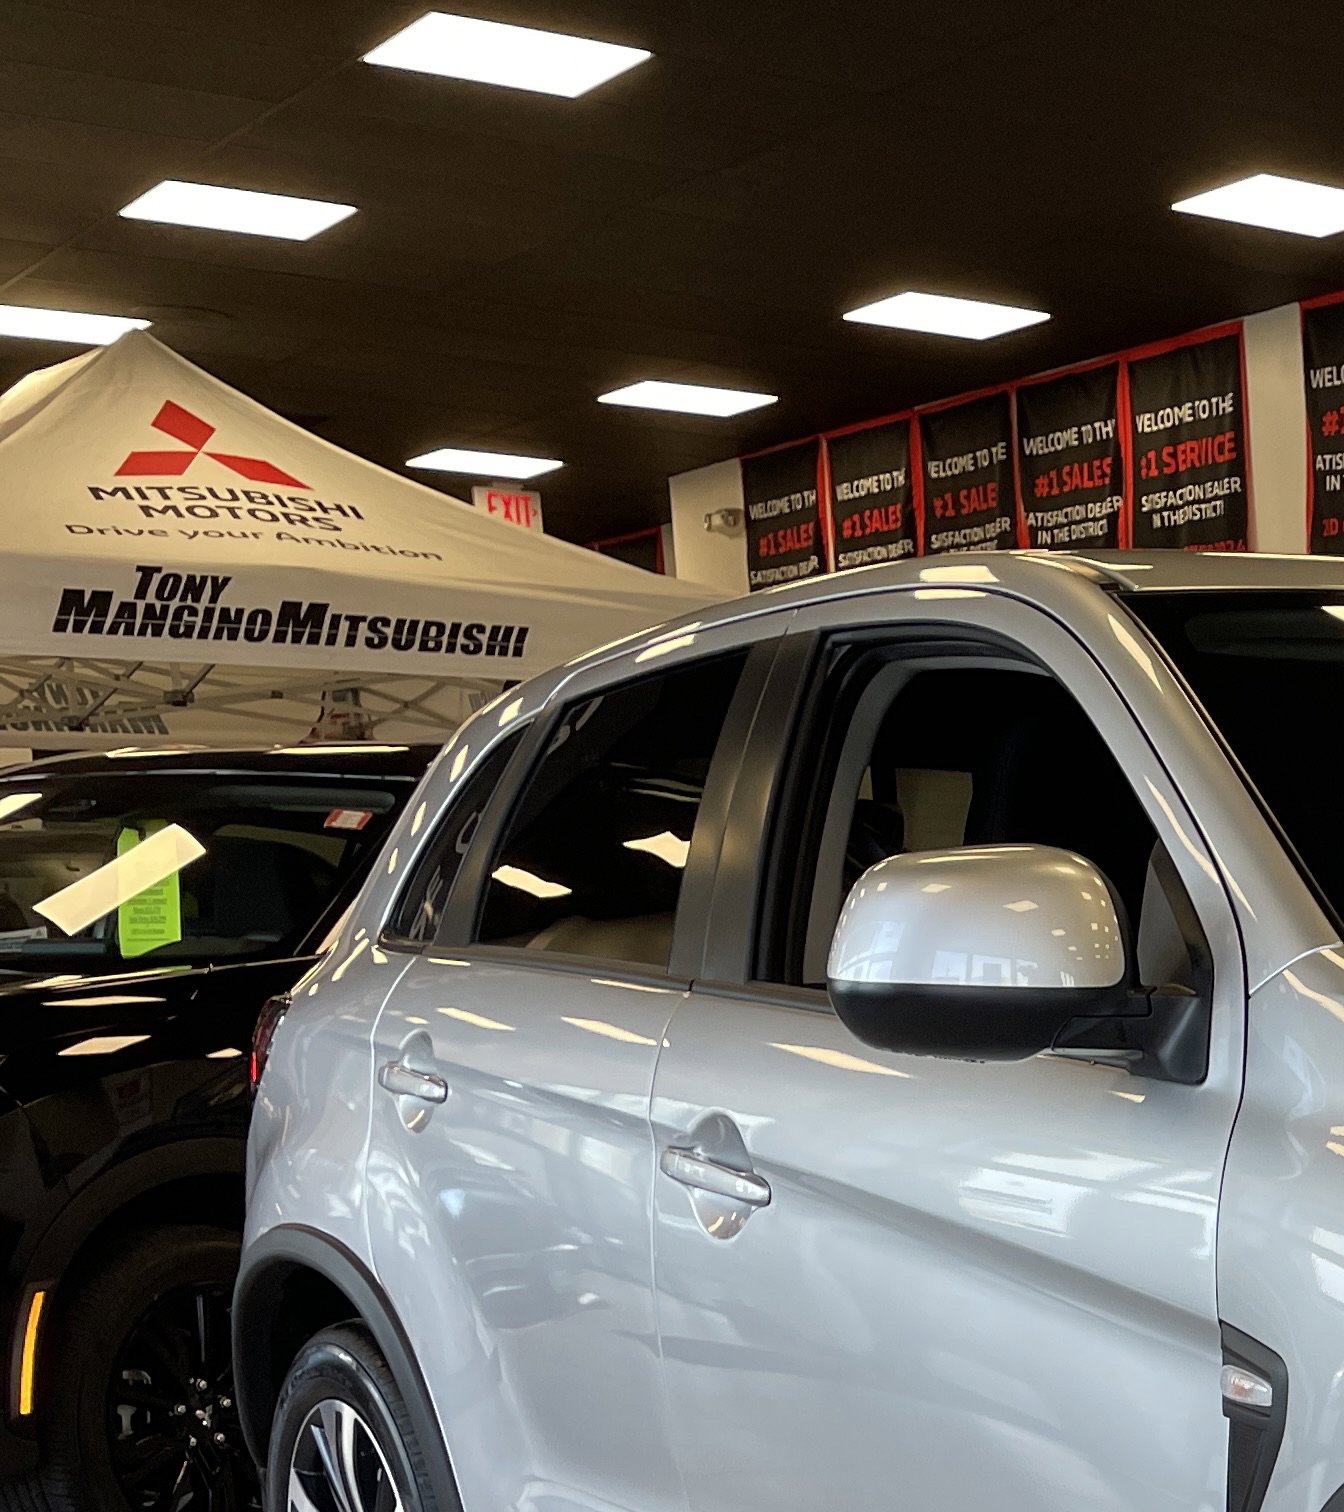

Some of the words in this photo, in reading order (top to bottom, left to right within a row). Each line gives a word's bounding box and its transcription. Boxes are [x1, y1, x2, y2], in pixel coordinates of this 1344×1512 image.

[1212, 391, 1235, 418] THE
[1022, 426, 1080, 457] WELCOME
[1080, 423, 1095, 446] TO
[1094, 417, 1116, 442] TH
[892, 466, 906, 488] TH
[927, 453, 975, 480] ELCOME
[1034, 468, 1060, 498] #1
[1062, 456, 1113, 493] SALES
[1325, 473, 1341, 492] IN
[87, 485, 364, 521] MITSUBISHI
[486, 490, 532, 529] EXIT
[959, 481, 999, 515] SALE
[141, 504, 343, 533] MOTORS
[842, 513, 864, 540] #1
[1026, 504, 1086, 528] ATISFACTION
[65, 523, 169, 538] Drive
[177, 527, 262, 541] your
[275, 530, 443, 562] Ambition
[759, 531, 775, 558] #1
[1037, 529, 1052, 545] IN
[132, 564, 233, 605] TONY
